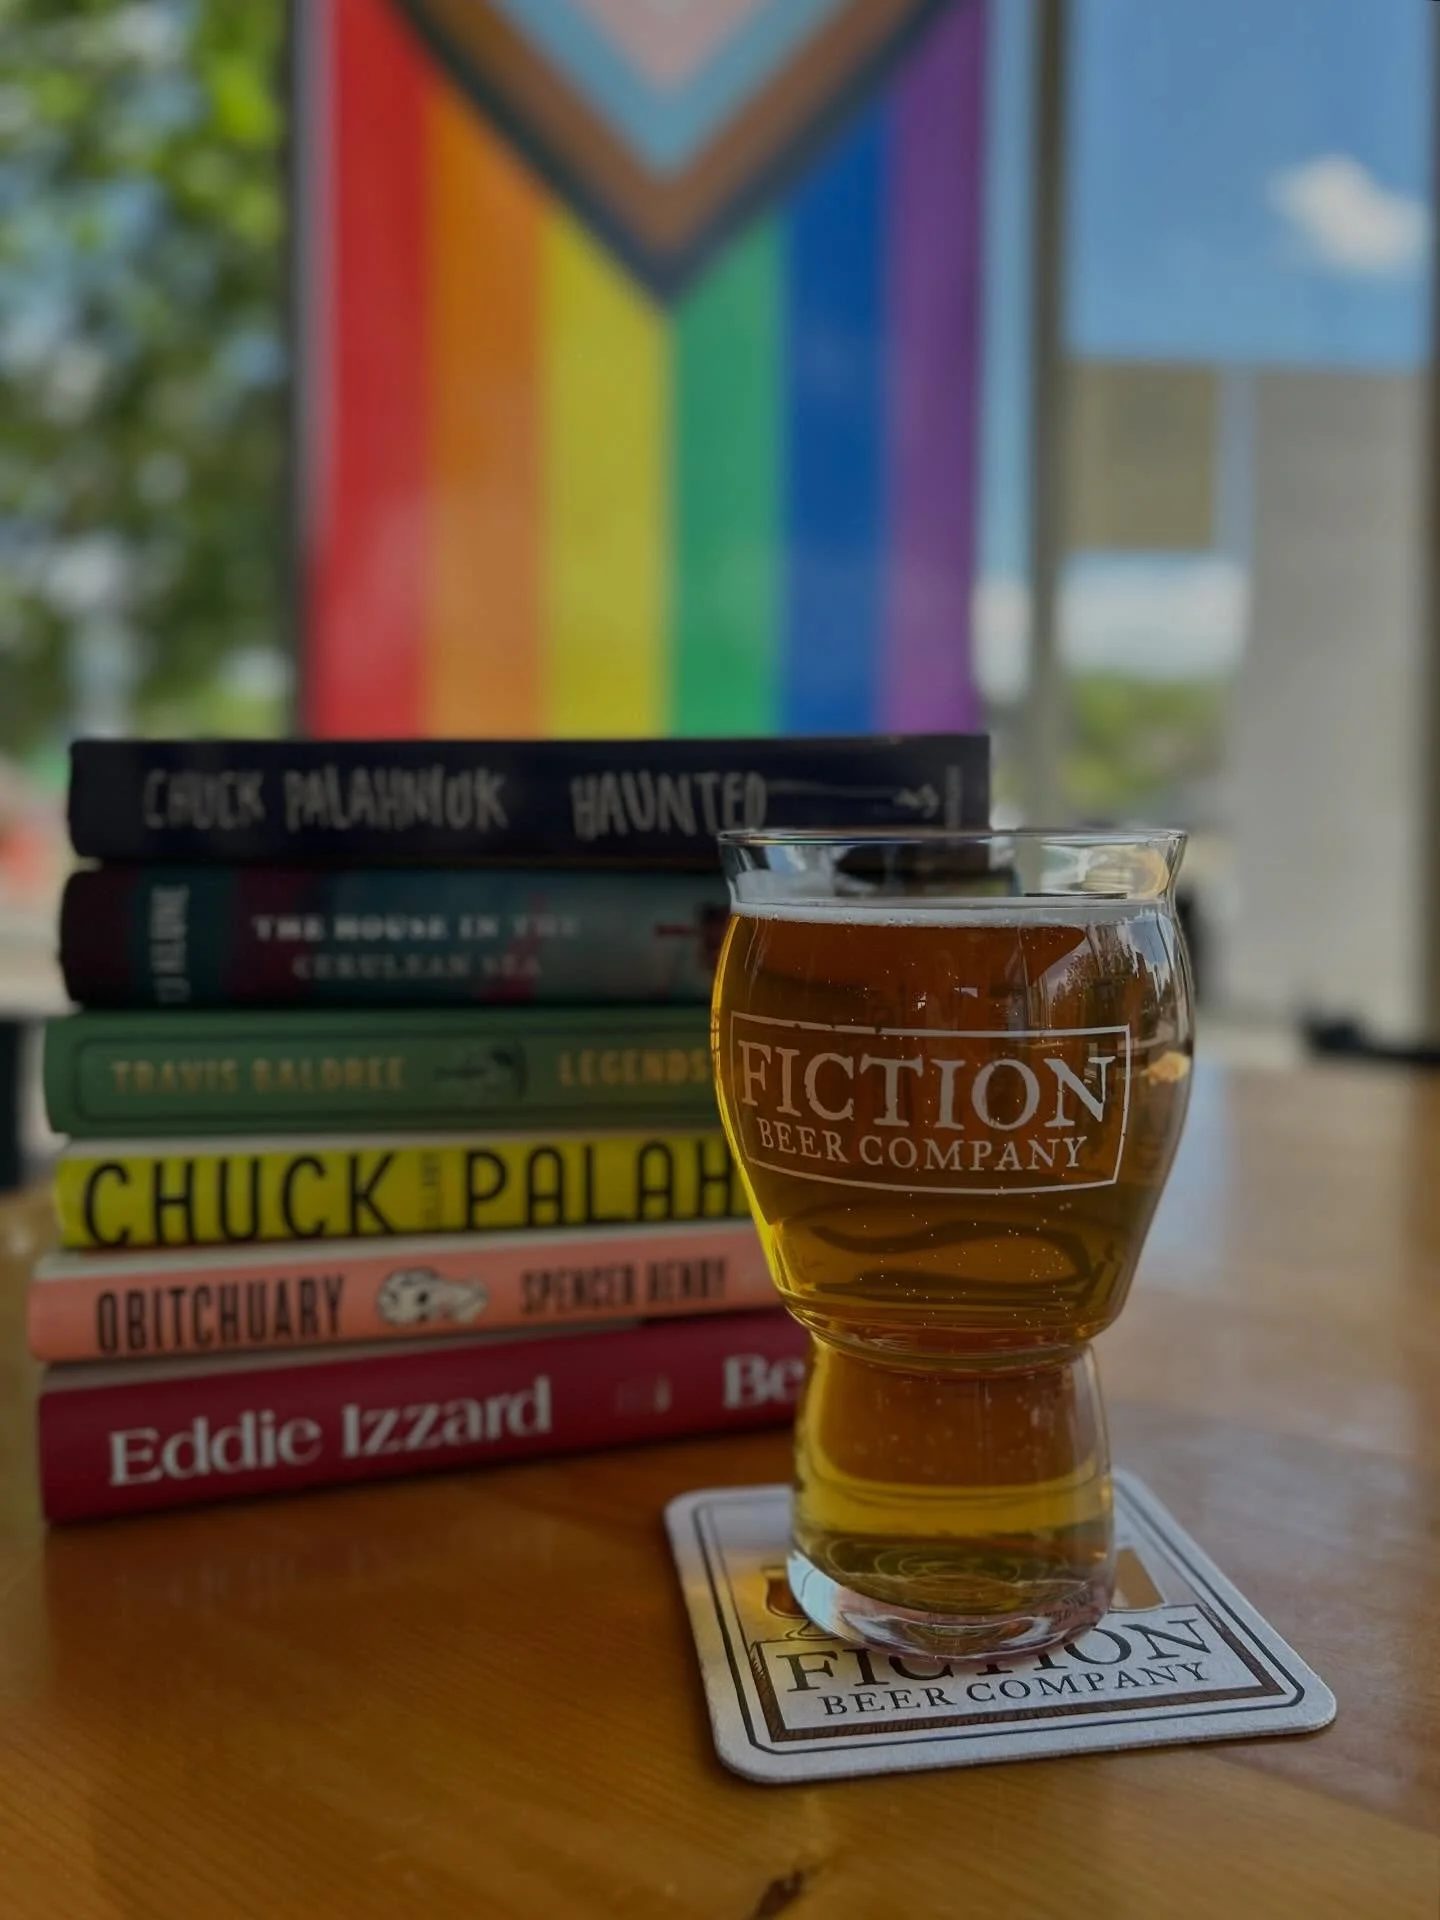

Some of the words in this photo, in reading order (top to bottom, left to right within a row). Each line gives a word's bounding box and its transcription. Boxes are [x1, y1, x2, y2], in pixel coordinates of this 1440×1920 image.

[143, 767, 266, 830] CHUCK
[570, 768, 769, 843] HAUNTED
[251, 913, 325, 942] THE
[334, 913, 449, 942] HOUSE
[459, 913, 499, 942] IN
[110, 1057, 239, 1095] TRAVIS
[557, 1048, 709, 1087] LEGENDS
[737, 1039, 1116, 1132] FICTION
[757, 1117, 849, 1163] BEER
[858, 1135, 1088, 1172] COMPANY
[83, 1153, 396, 1248] CHUCK
[465, 1137, 731, 1230] PALAH
[97, 1274, 343, 1353] OBITCHUARY
[108, 1408, 323, 1488] Eddie
[341, 1374, 552, 1461] Izzard
[817, 1687, 957, 1716] BEER
[966, 1662, 1211, 1702] COMPANY
